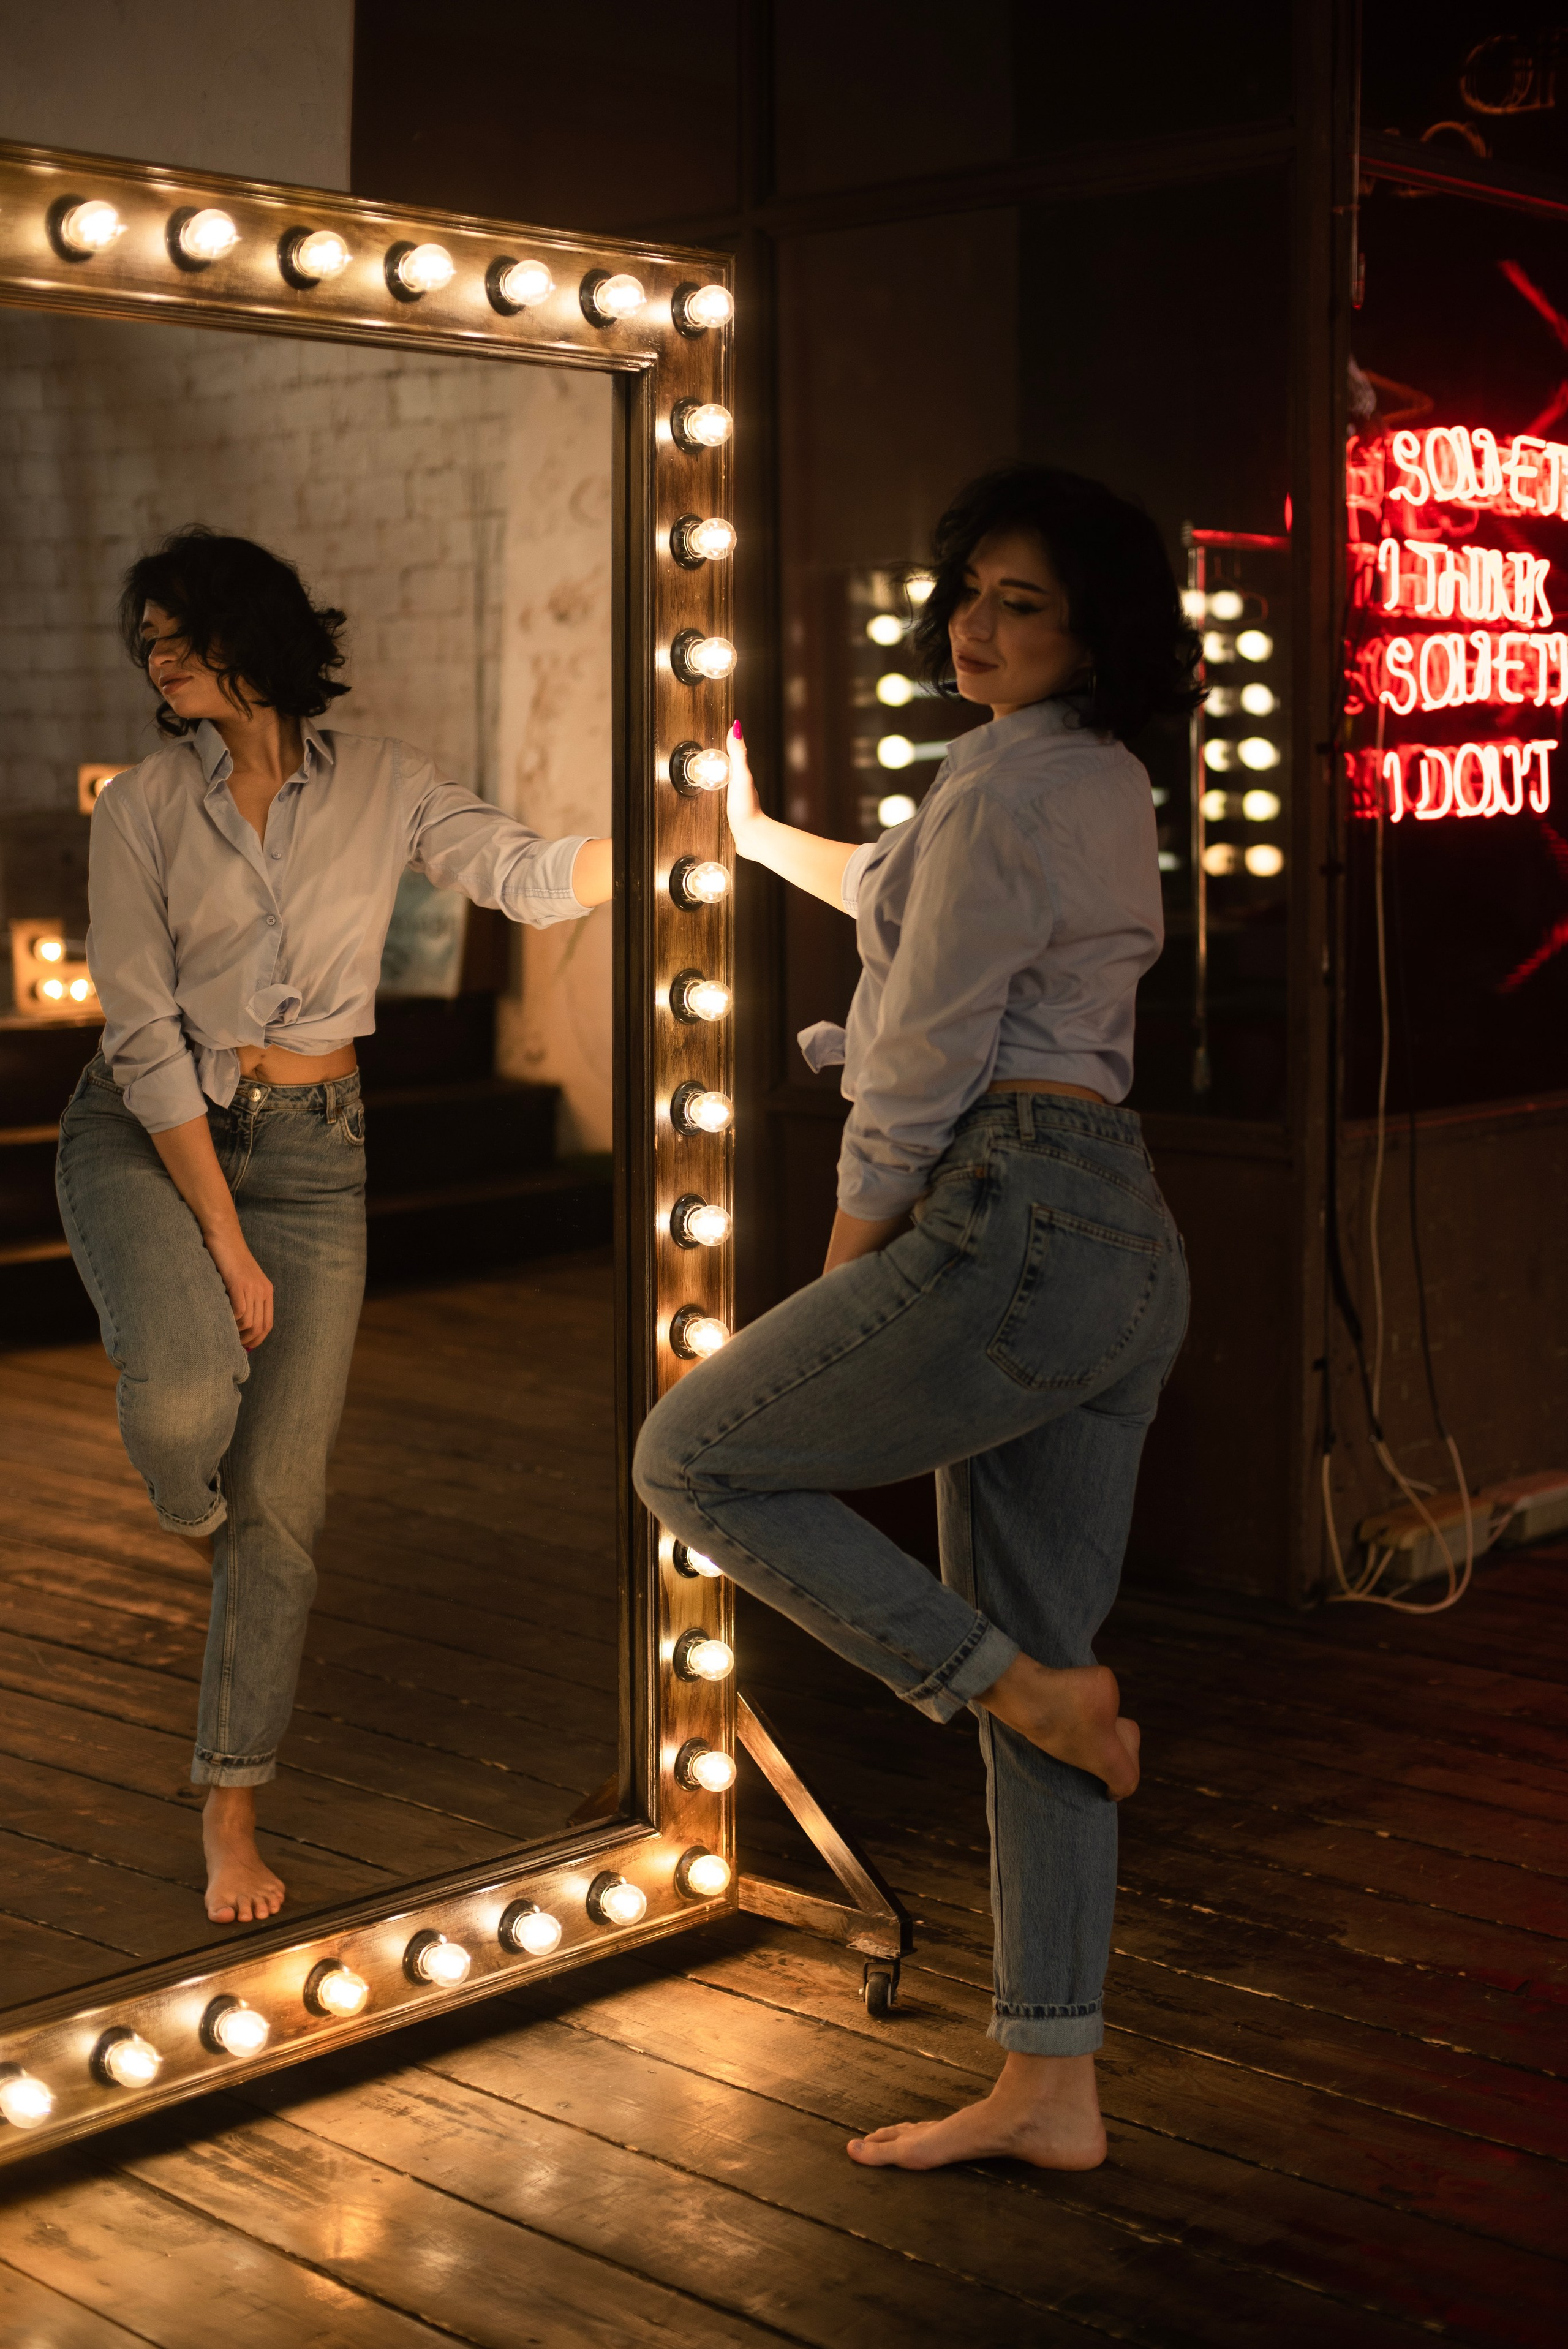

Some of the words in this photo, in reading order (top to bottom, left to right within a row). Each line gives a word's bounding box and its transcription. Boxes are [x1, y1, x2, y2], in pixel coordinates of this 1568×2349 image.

[1378, 537, 1401, 612] I
[1402, 538, 1554, 629] THINK
[1382, 751, 1404, 823] I
